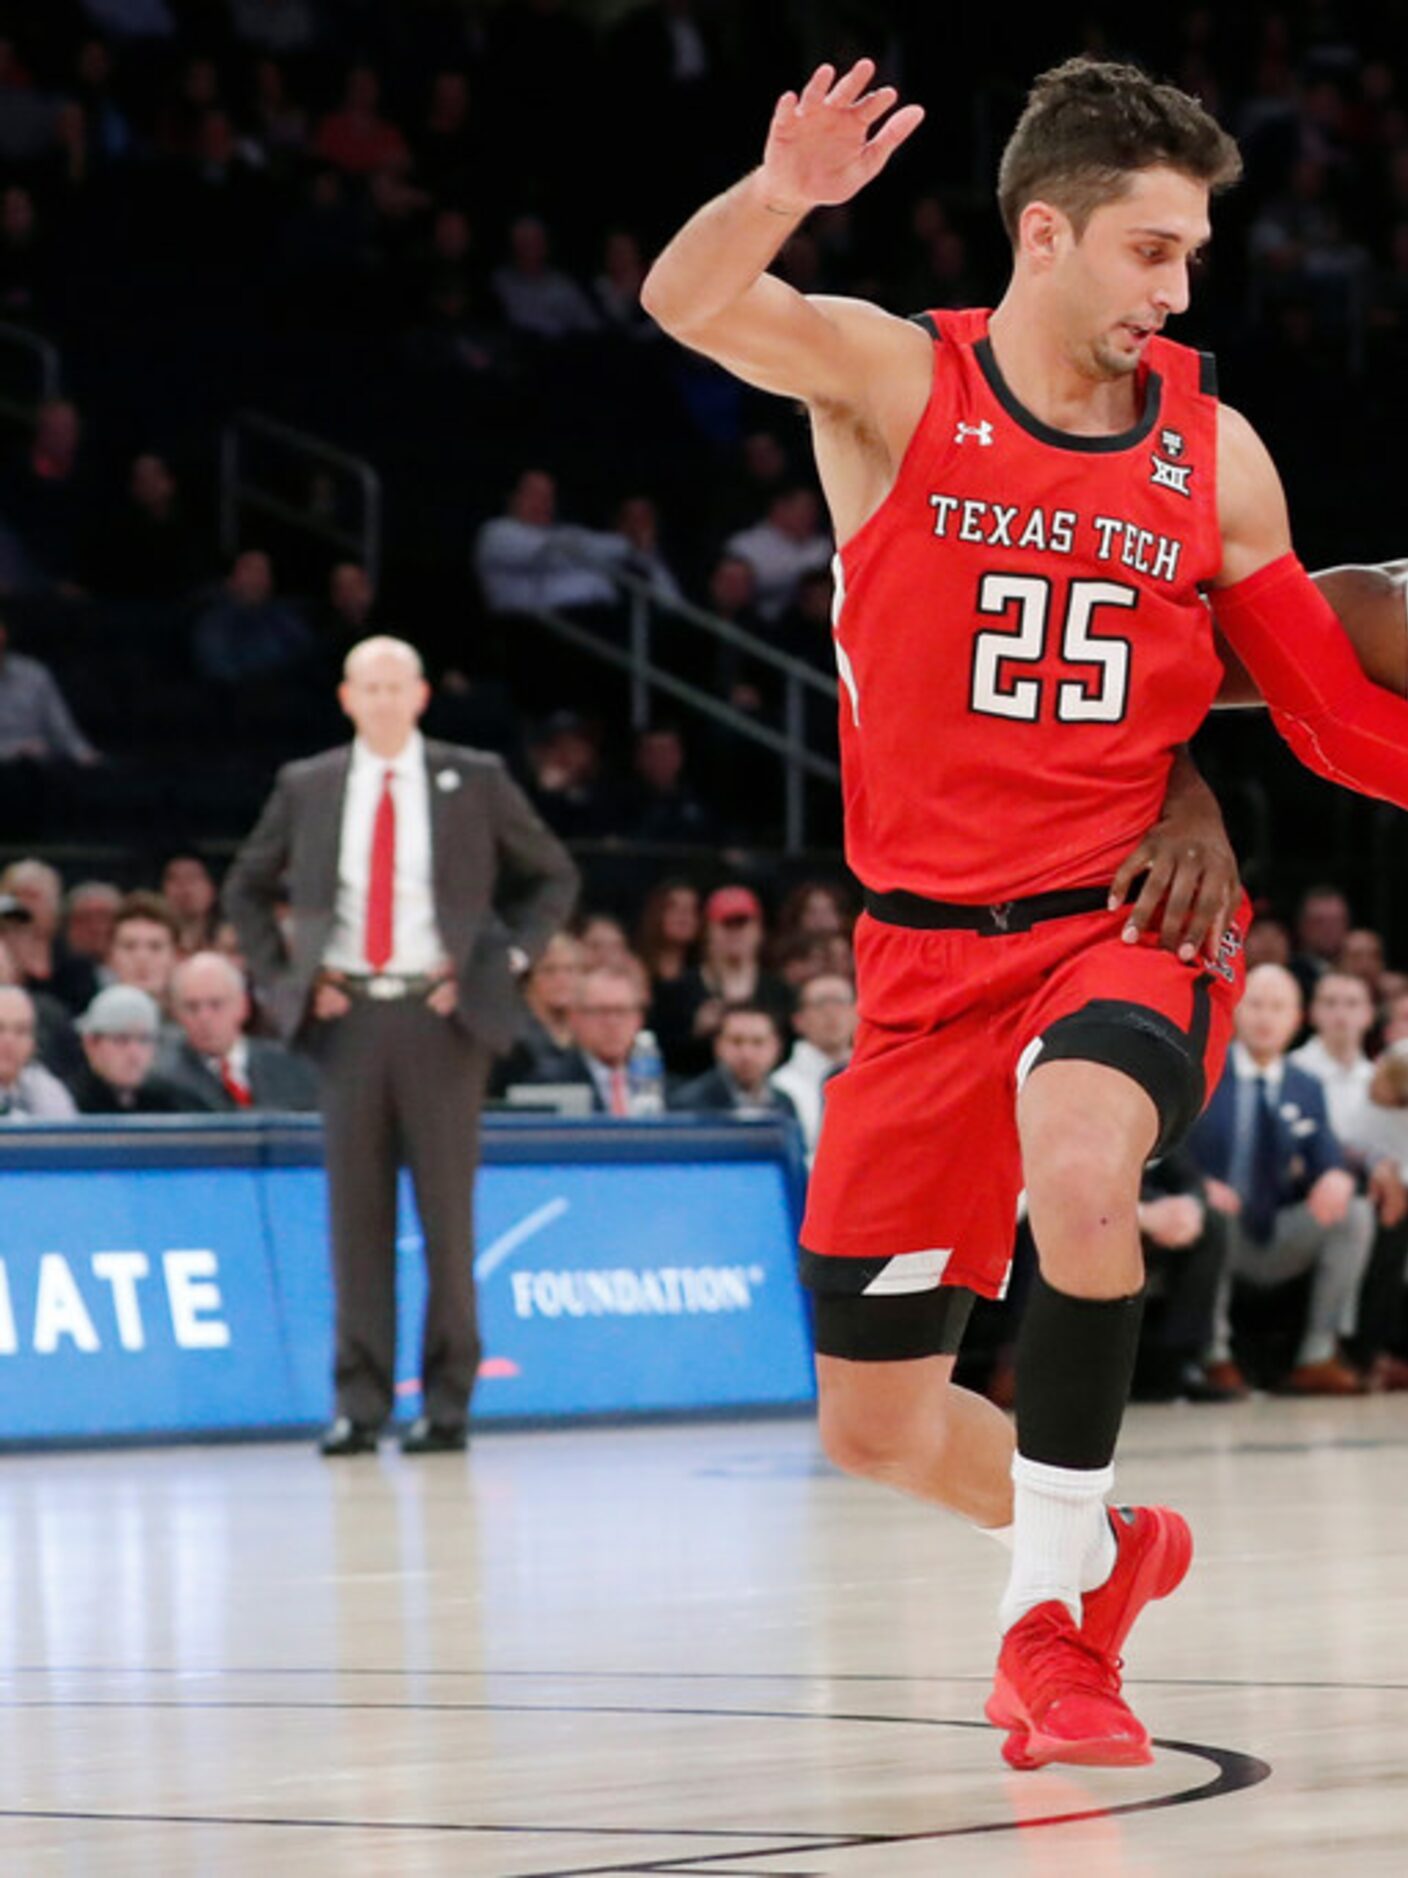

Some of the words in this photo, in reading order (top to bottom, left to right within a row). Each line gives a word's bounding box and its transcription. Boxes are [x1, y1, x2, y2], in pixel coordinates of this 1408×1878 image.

[930, 494, 1077, 553] TEXAS
[1094, 516, 1181, 581] TECH
[969, 570, 1138, 724] 25
